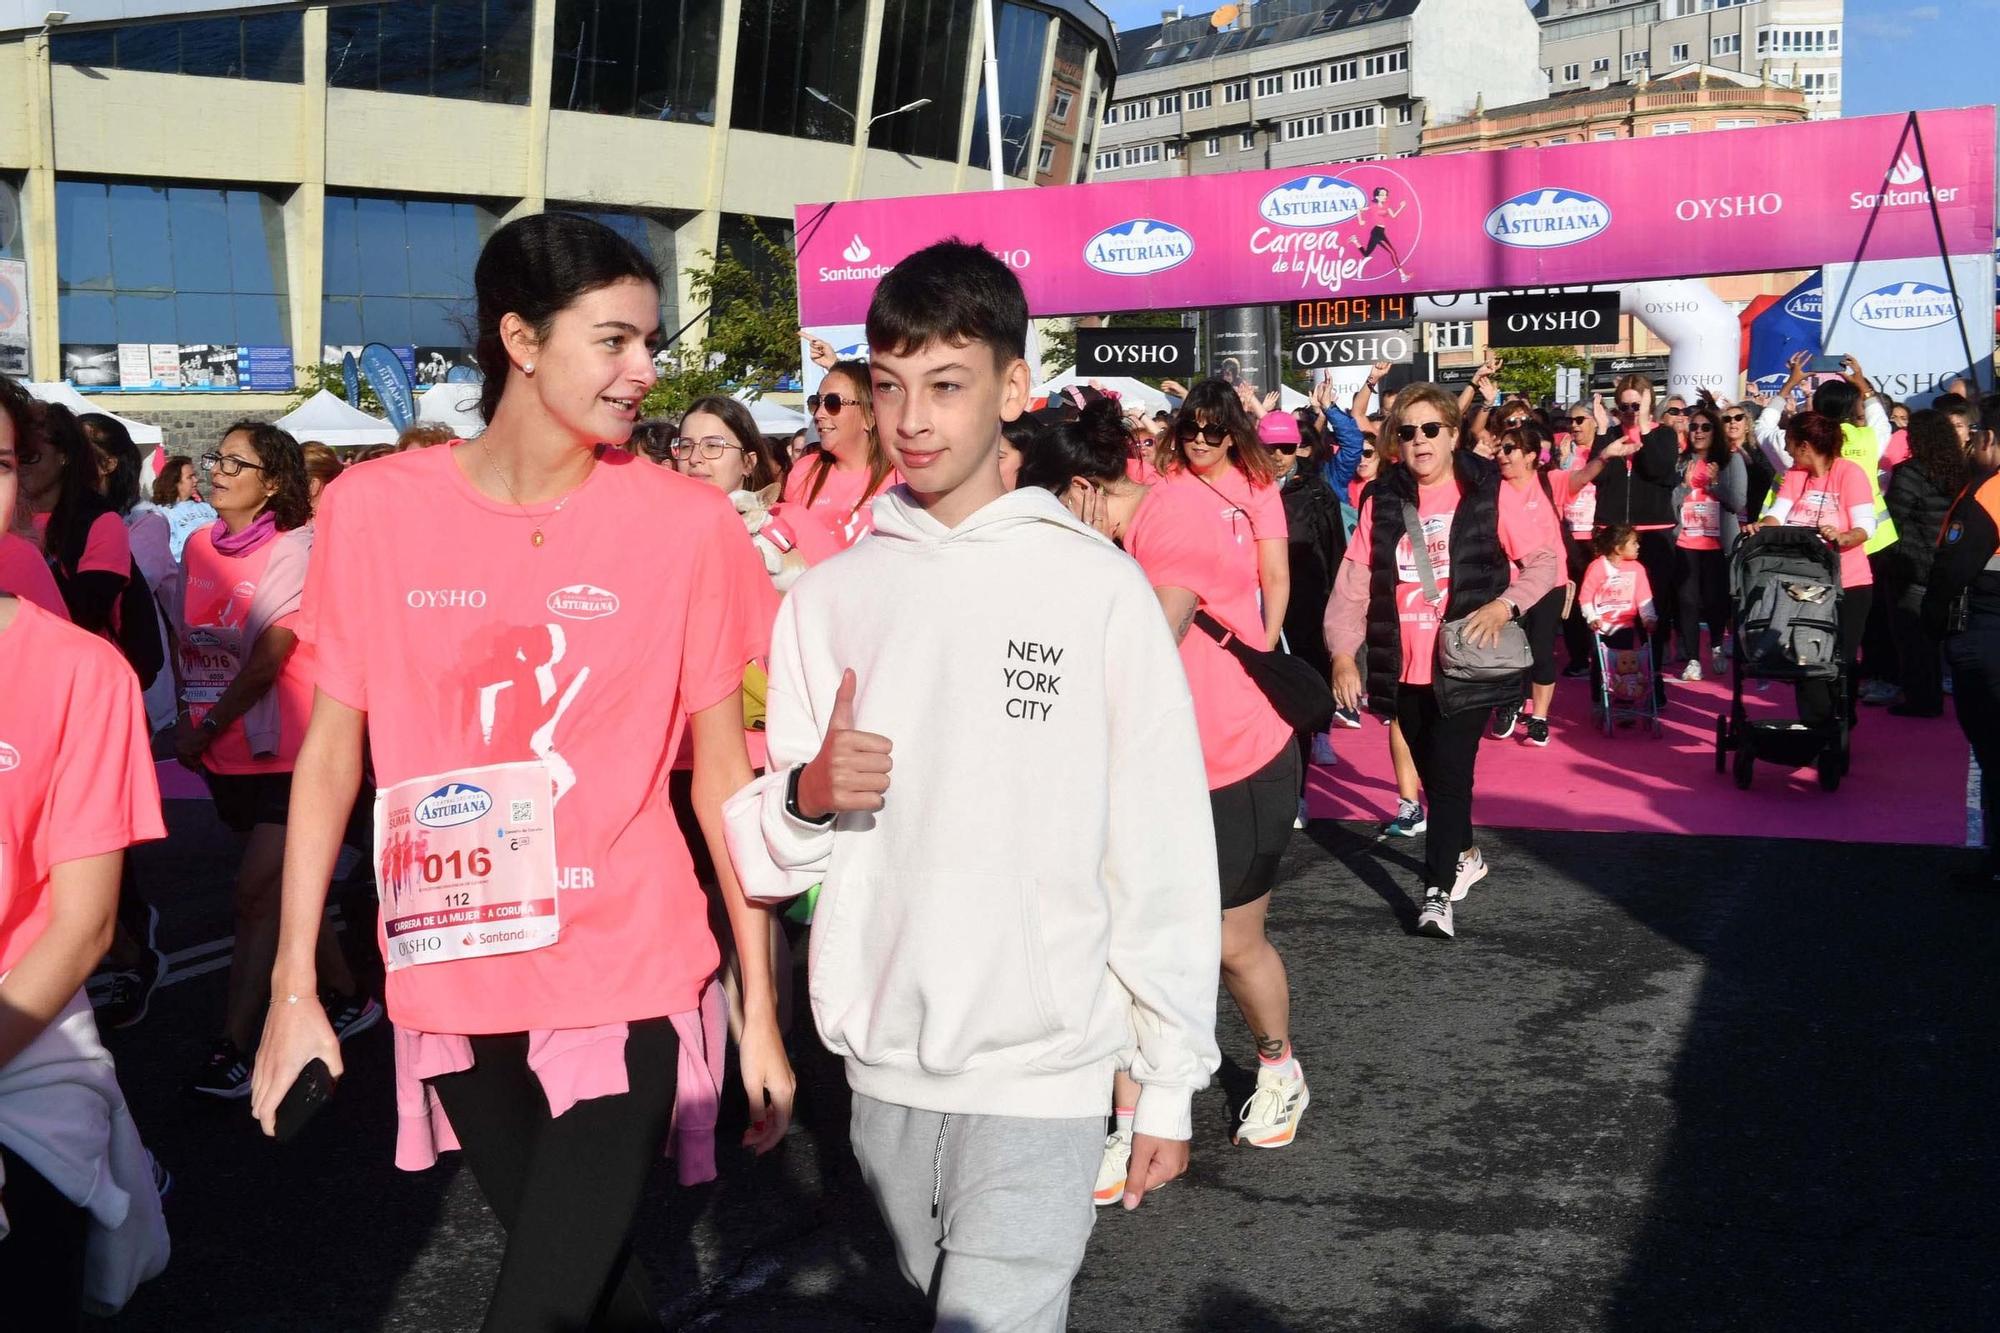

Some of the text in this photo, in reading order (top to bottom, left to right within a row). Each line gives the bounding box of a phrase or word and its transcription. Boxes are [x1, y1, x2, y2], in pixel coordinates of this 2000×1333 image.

[1267, 197, 1359, 217] ASTURIANA
[1676, 193, 1783, 221] OYSHO
[1850, 186, 1959, 209] Santander
[1493, 212, 1602, 235] ASTURIANA
[1250, 226, 1341, 255] Carrera
[1092, 242, 1186, 263] ASTURIANA
[1272, 247, 1374, 292] de la Mujer
[1298, 297, 1404, 328] 00:09:14
[1645, 300, 1699, 314] OYSHO
[1859, 302, 1955, 321] ASTURIANA
[1507, 309, 1601, 332] OYSHO
[1094, 344, 1179, 364] OYSHO
[1296, 337, 1408, 366] OYSHO
[1333, 383, 1360, 394] SHO
[1672, 373, 1723, 386] OYSHO
[1872, 371, 1963, 396] YSHO
[407, 589, 487, 608] OYSHO
[551, 595, 613, 612] ASTURIANA
[202, 655, 230, 668] 016
[1007, 639, 1064, 666] NEW
[1003, 667, 1061, 695] YORK
[1006, 698, 1053, 721] CITY
[420, 800, 487, 821] ASTURIANA
[422, 847, 492, 884] 016
[445, 893, 470, 907] 112
[394, 918, 421, 932] CARRERA
[423, 917, 435, 926] DE
[437, 914, 448, 925] LA
[449, 910, 480, 923] MUJER
[487, 908, 494, 919] A
[479, 929, 537, 945] Santand
